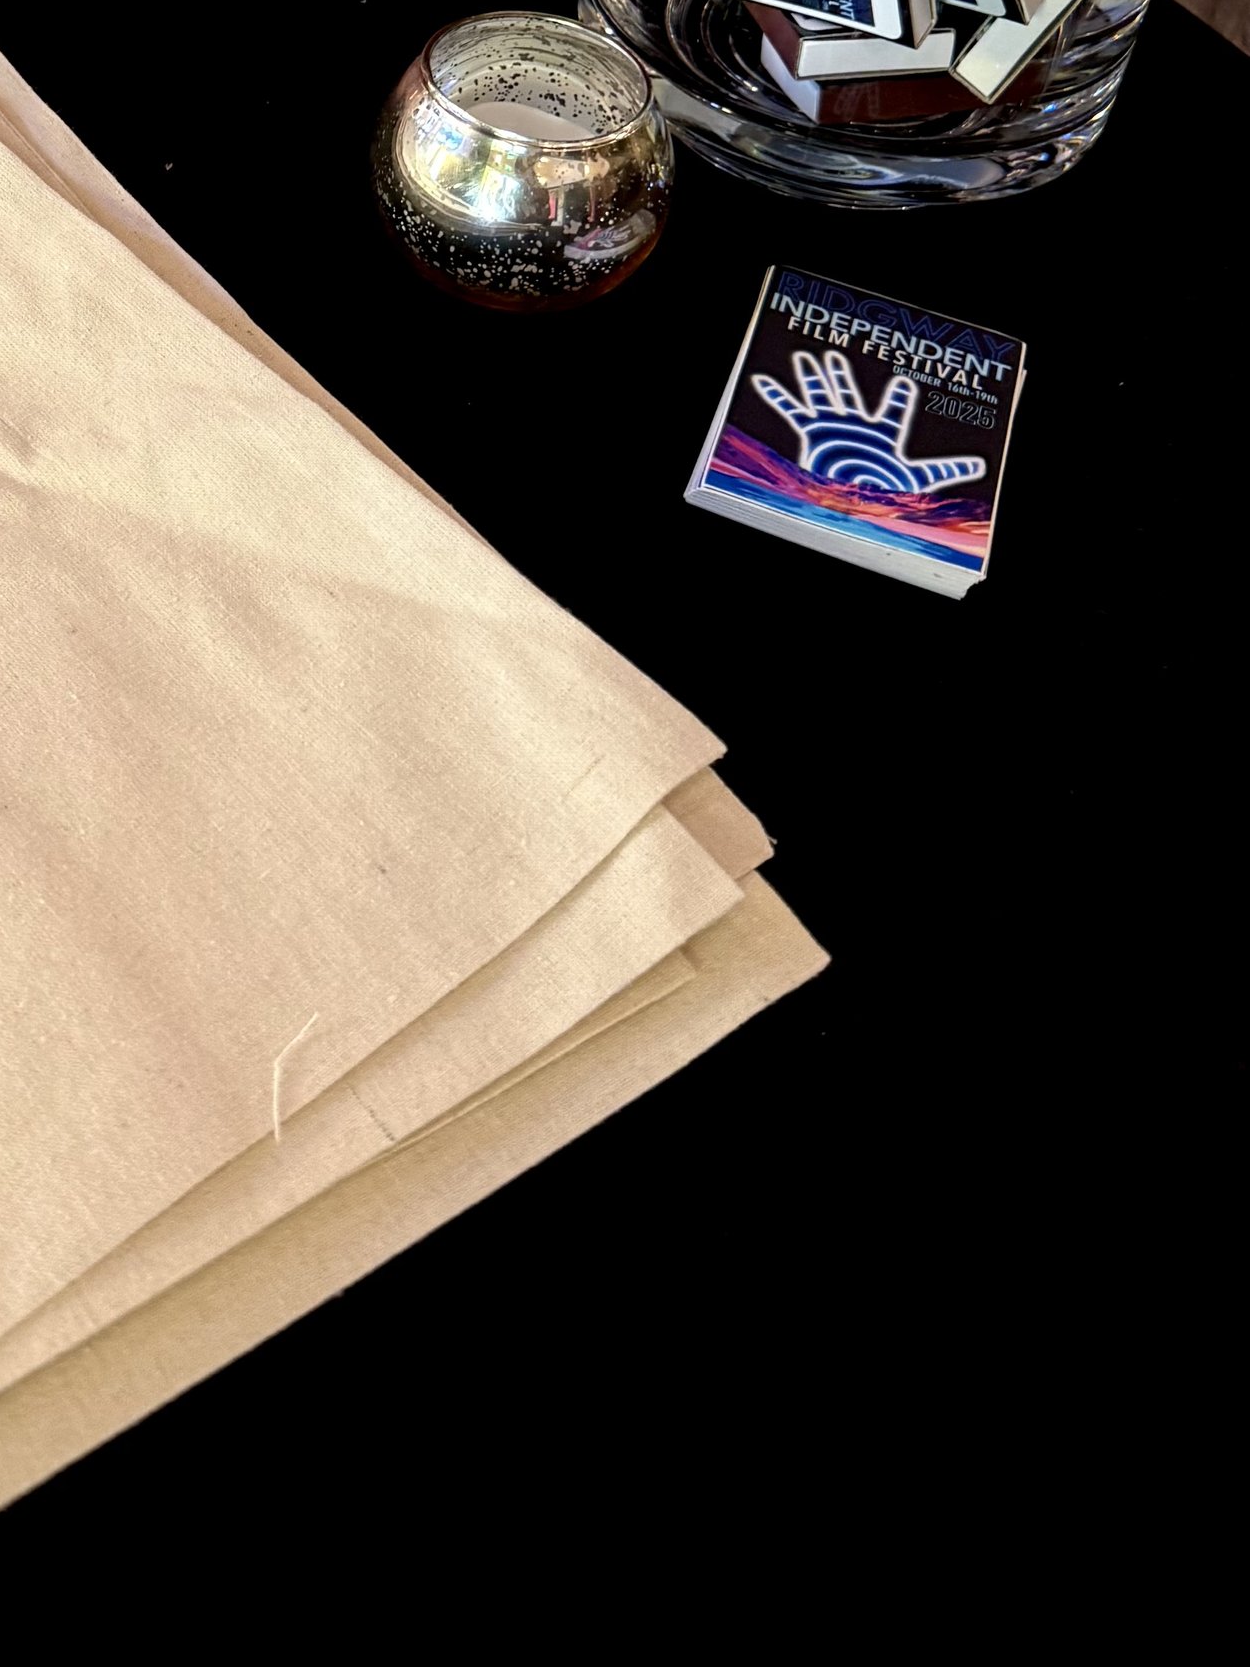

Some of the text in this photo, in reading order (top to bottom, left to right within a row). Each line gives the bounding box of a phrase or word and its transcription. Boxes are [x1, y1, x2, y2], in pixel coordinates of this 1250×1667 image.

[769, 292, 1013, 382] INDEPENDENT
[777, 271, 1017, 362] RIDGWAY
[787, 316, 984, 390] FILM FESTIVAL
[892, 365, 998, 406] OCTOBER 16th-19th
[924, 391, 997, 430] 2025
